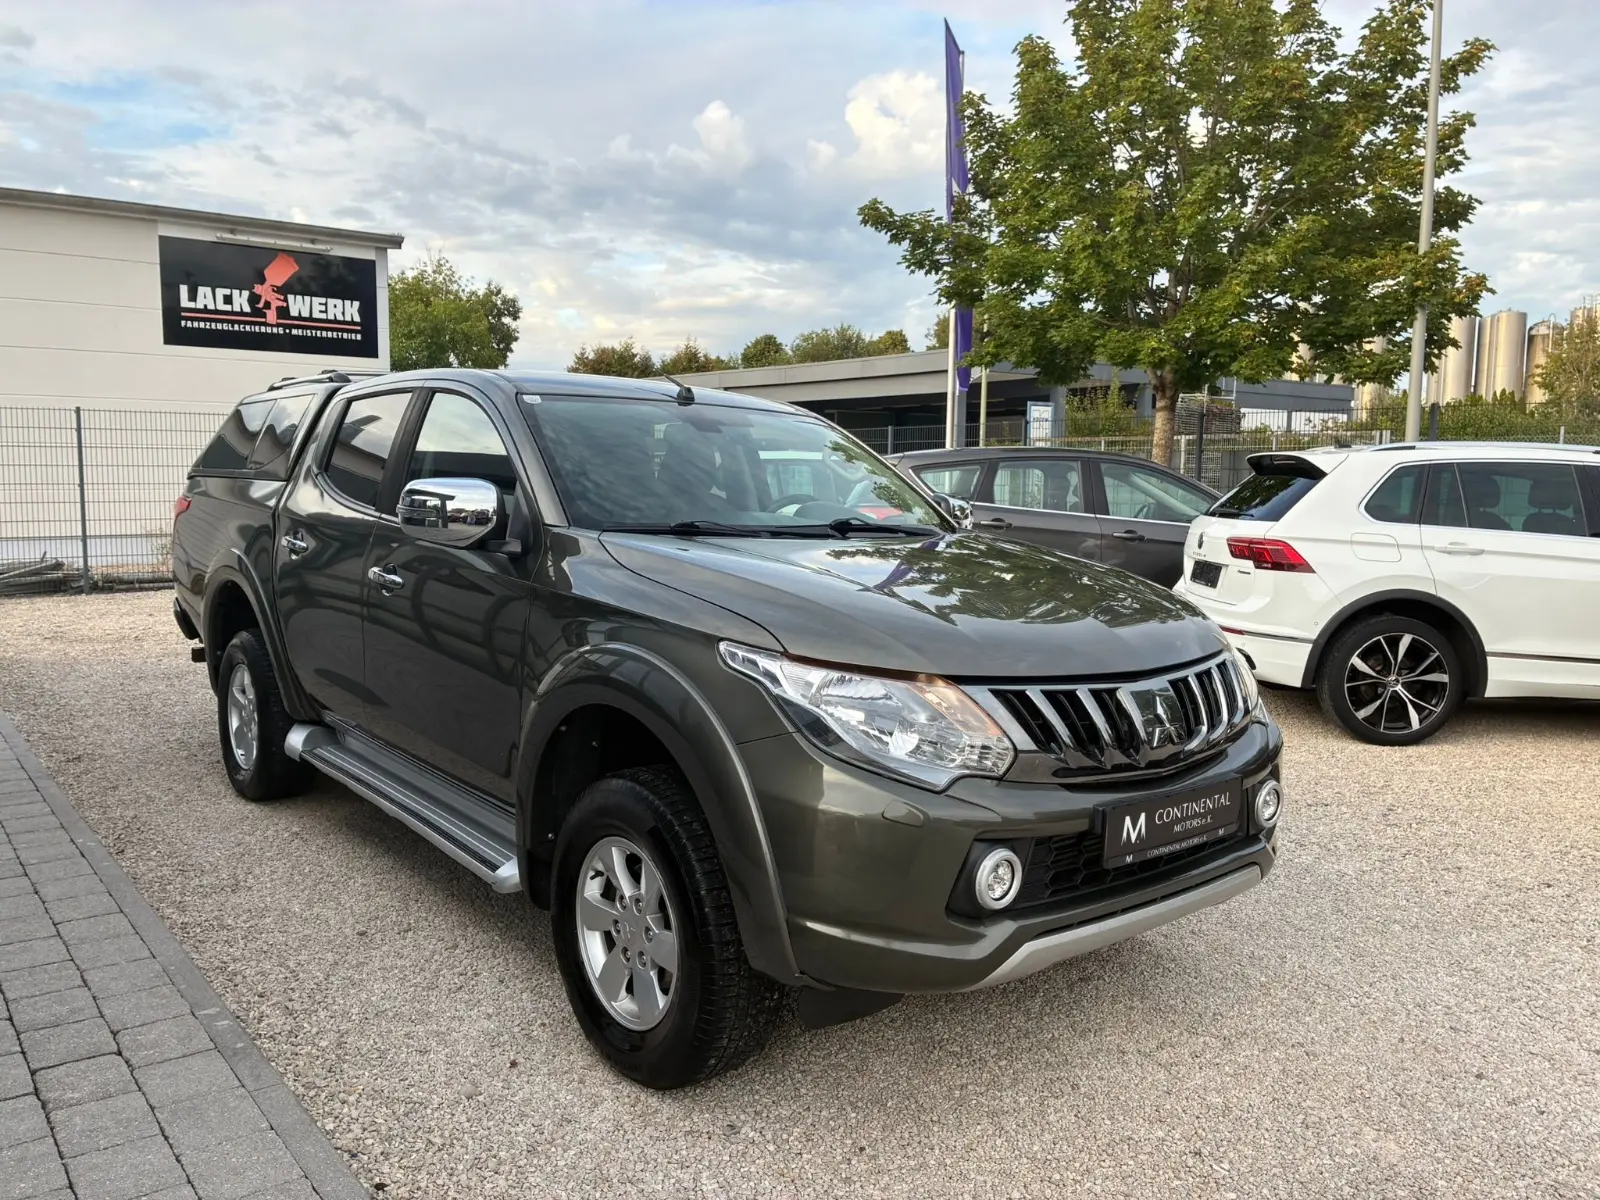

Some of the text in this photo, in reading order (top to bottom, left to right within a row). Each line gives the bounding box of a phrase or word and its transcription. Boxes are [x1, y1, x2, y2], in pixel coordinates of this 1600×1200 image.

[179, 284, 361, 322] LACK WERK
[181, 320, 362, 341] FAHRZEUGLACKIERUNG MEISTERBETRIEB
[1155, 792, 1231, 824] CONTINENTAL
[1173, 818, 1201, 833] MOTORS
[1147, 842, 1180, 857] CONTINENTAL
[1181, 837, 1200, 848] MOTORS
